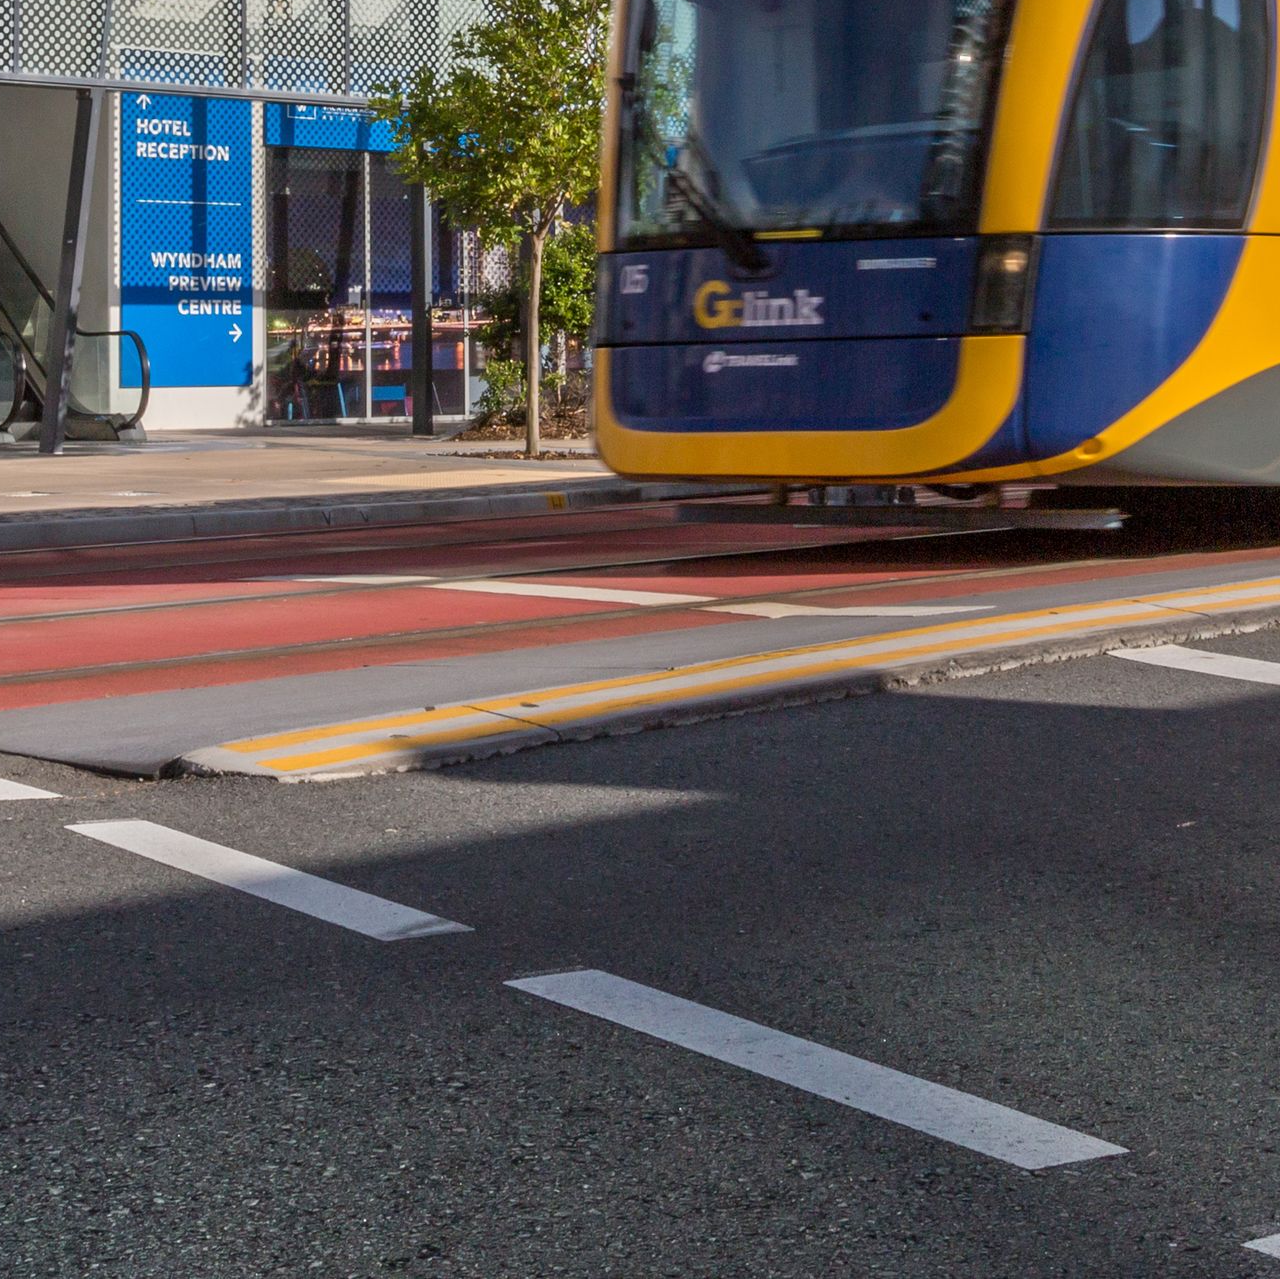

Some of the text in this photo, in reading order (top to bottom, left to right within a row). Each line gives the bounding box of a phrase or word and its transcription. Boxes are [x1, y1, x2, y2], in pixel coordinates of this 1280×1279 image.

[136, 118, 191, 136] HOTEL
[136, 141, 230, 161] RECEPTION
[151, 252, 241, 269] WYNDHAM
[168, 276, 242, 291] PREVIEW
[178, 299, 242, 315] CENTRE
